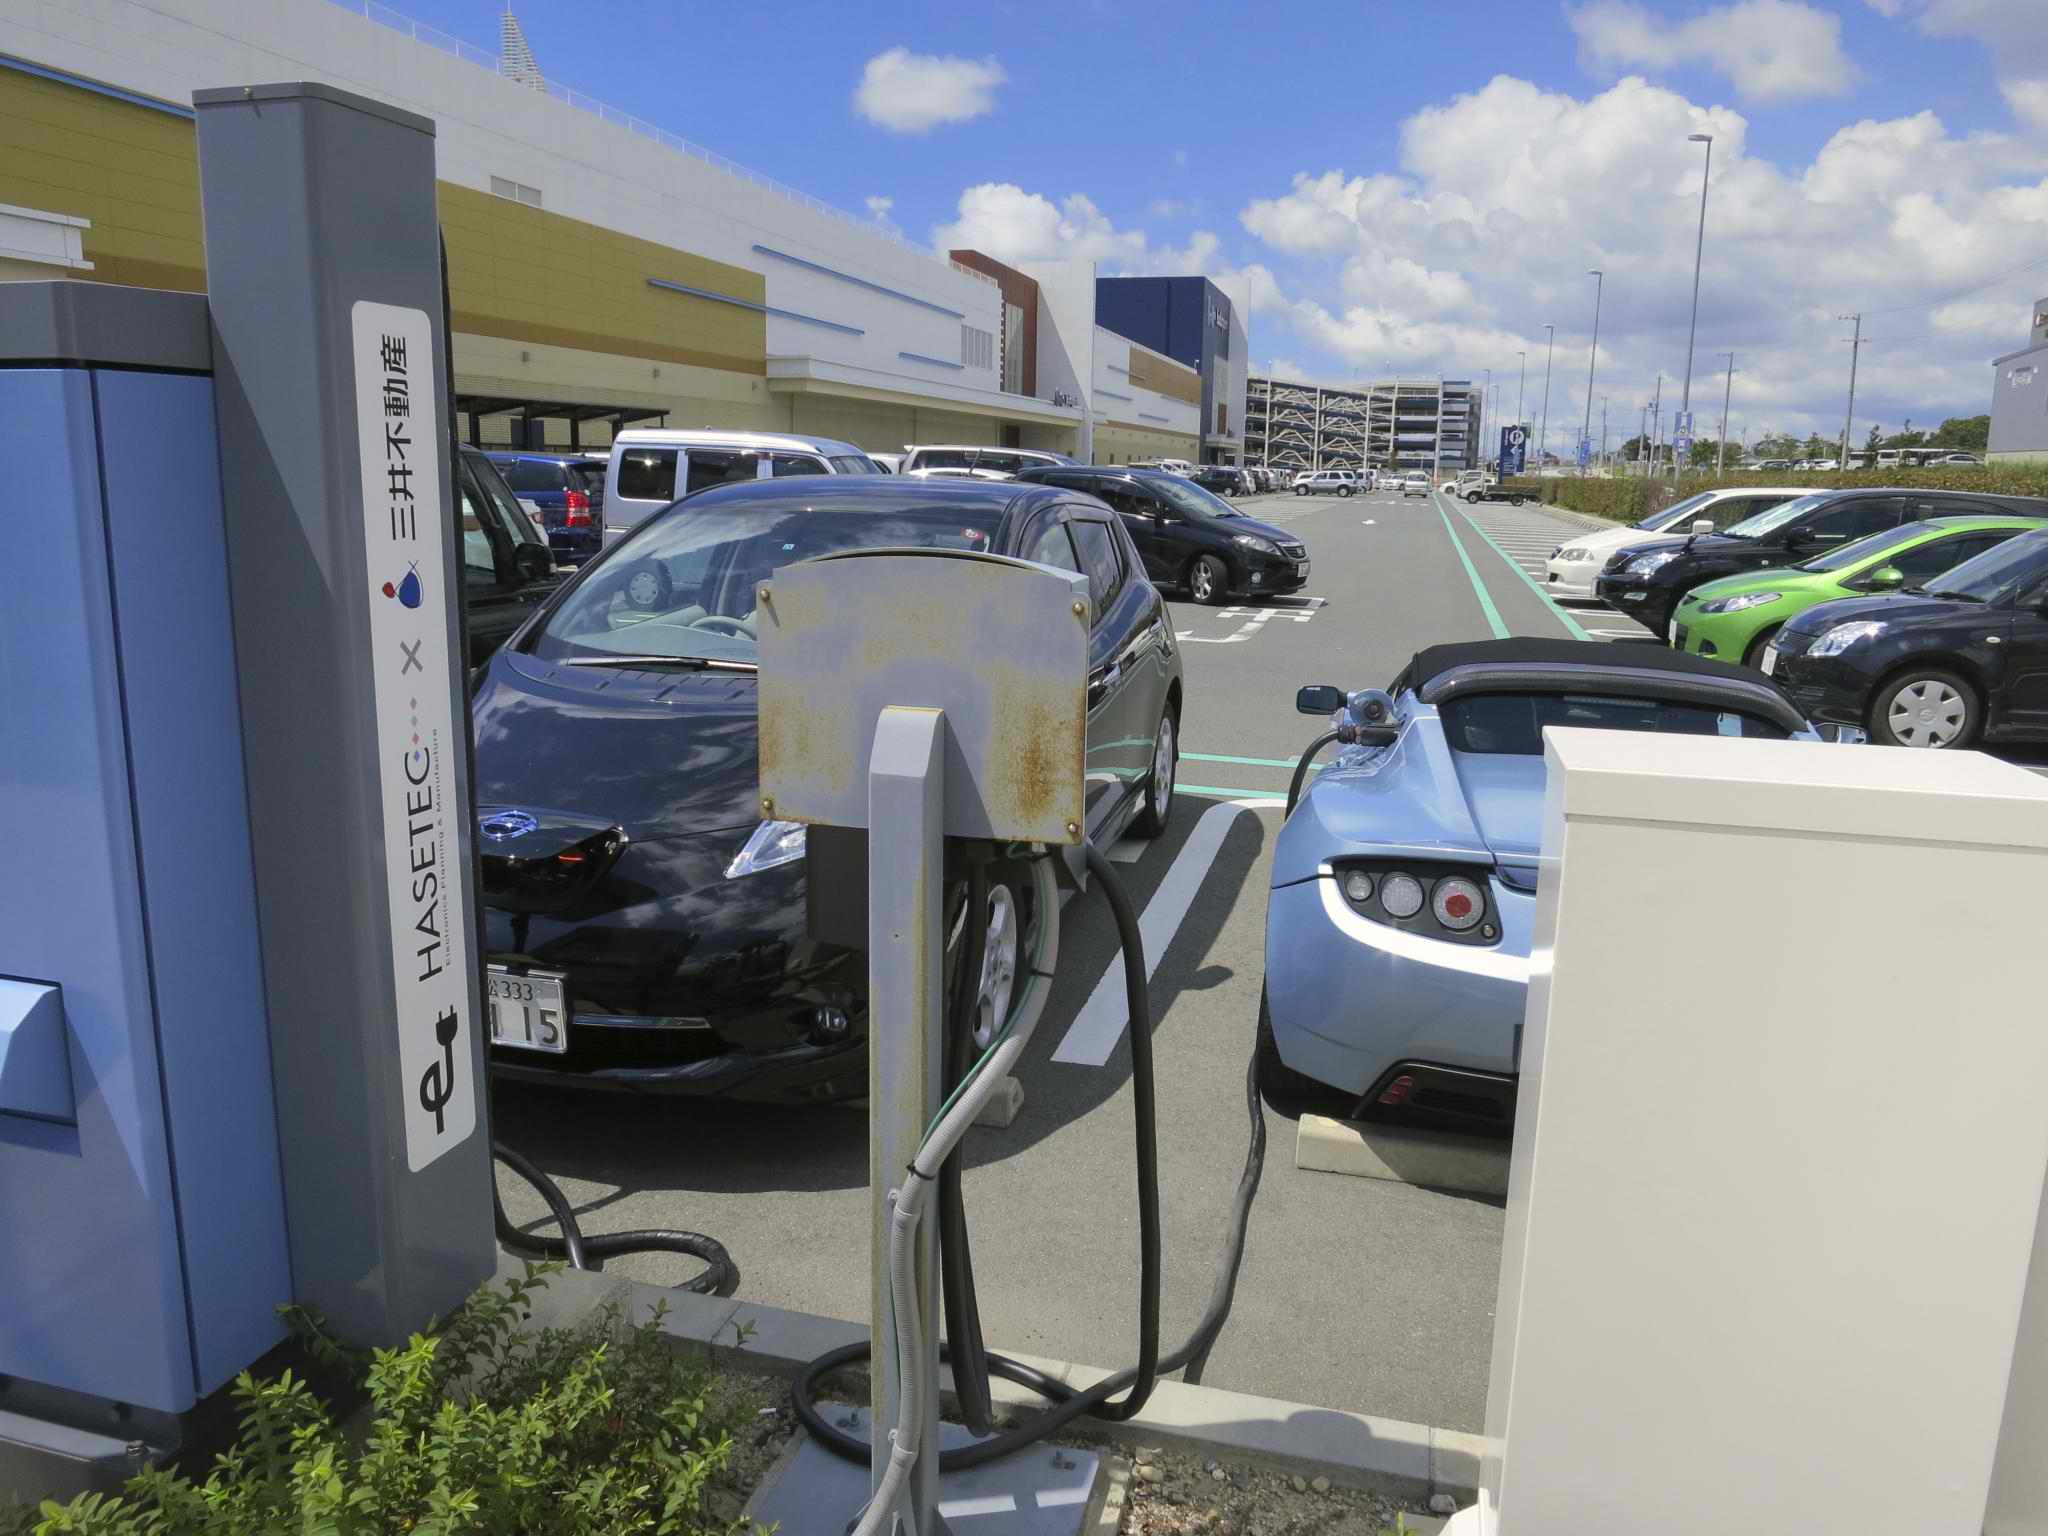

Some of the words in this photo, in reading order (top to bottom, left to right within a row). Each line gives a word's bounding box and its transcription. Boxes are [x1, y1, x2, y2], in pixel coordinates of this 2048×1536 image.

[380, 334, 415, 540] 三井不動産
[432, 728, 442, 812] Manufacture
[404, 747, 443, 982] HASETEC
[438, 832, 447, 889] Planning
[442, 894, 451, 966] Electronics
